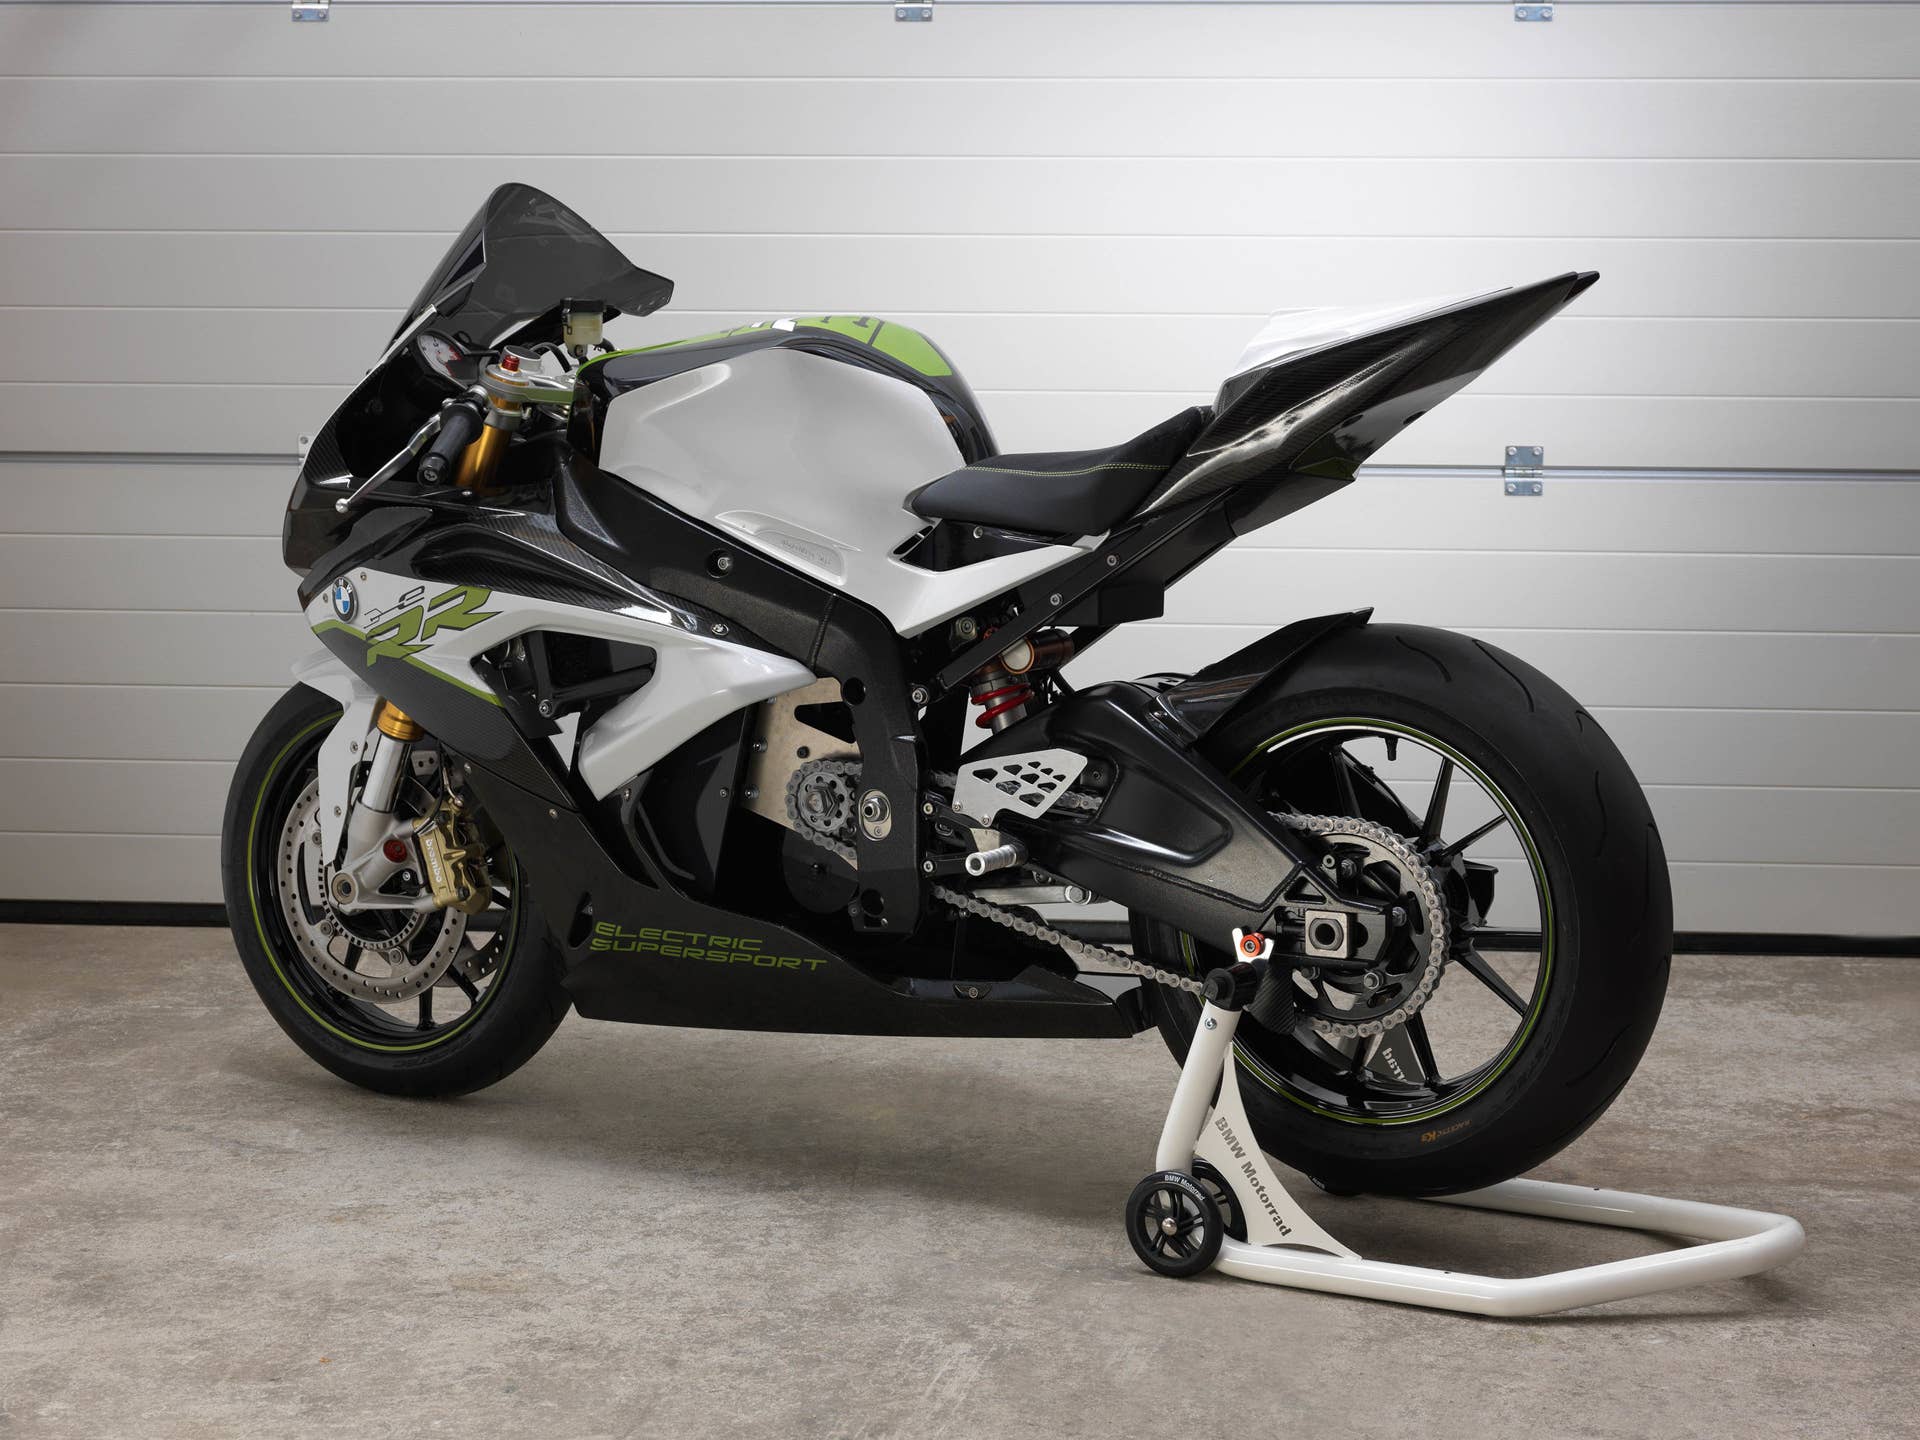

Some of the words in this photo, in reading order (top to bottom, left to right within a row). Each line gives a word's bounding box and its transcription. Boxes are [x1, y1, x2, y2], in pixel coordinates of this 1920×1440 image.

[425, 839, 443, 884] brembo
[594, 920, 764, 951] ELECTRIC
[589, 937, 828, 971] SUPERSPORT
[1164, 1174, 1181, 1182] BMW
[1180, 1178, 1206, 1201] Motorrad
[1214, 1116, 1246, 1160] BMW
[1240, 1160, 1293, 1237] Motorrad
